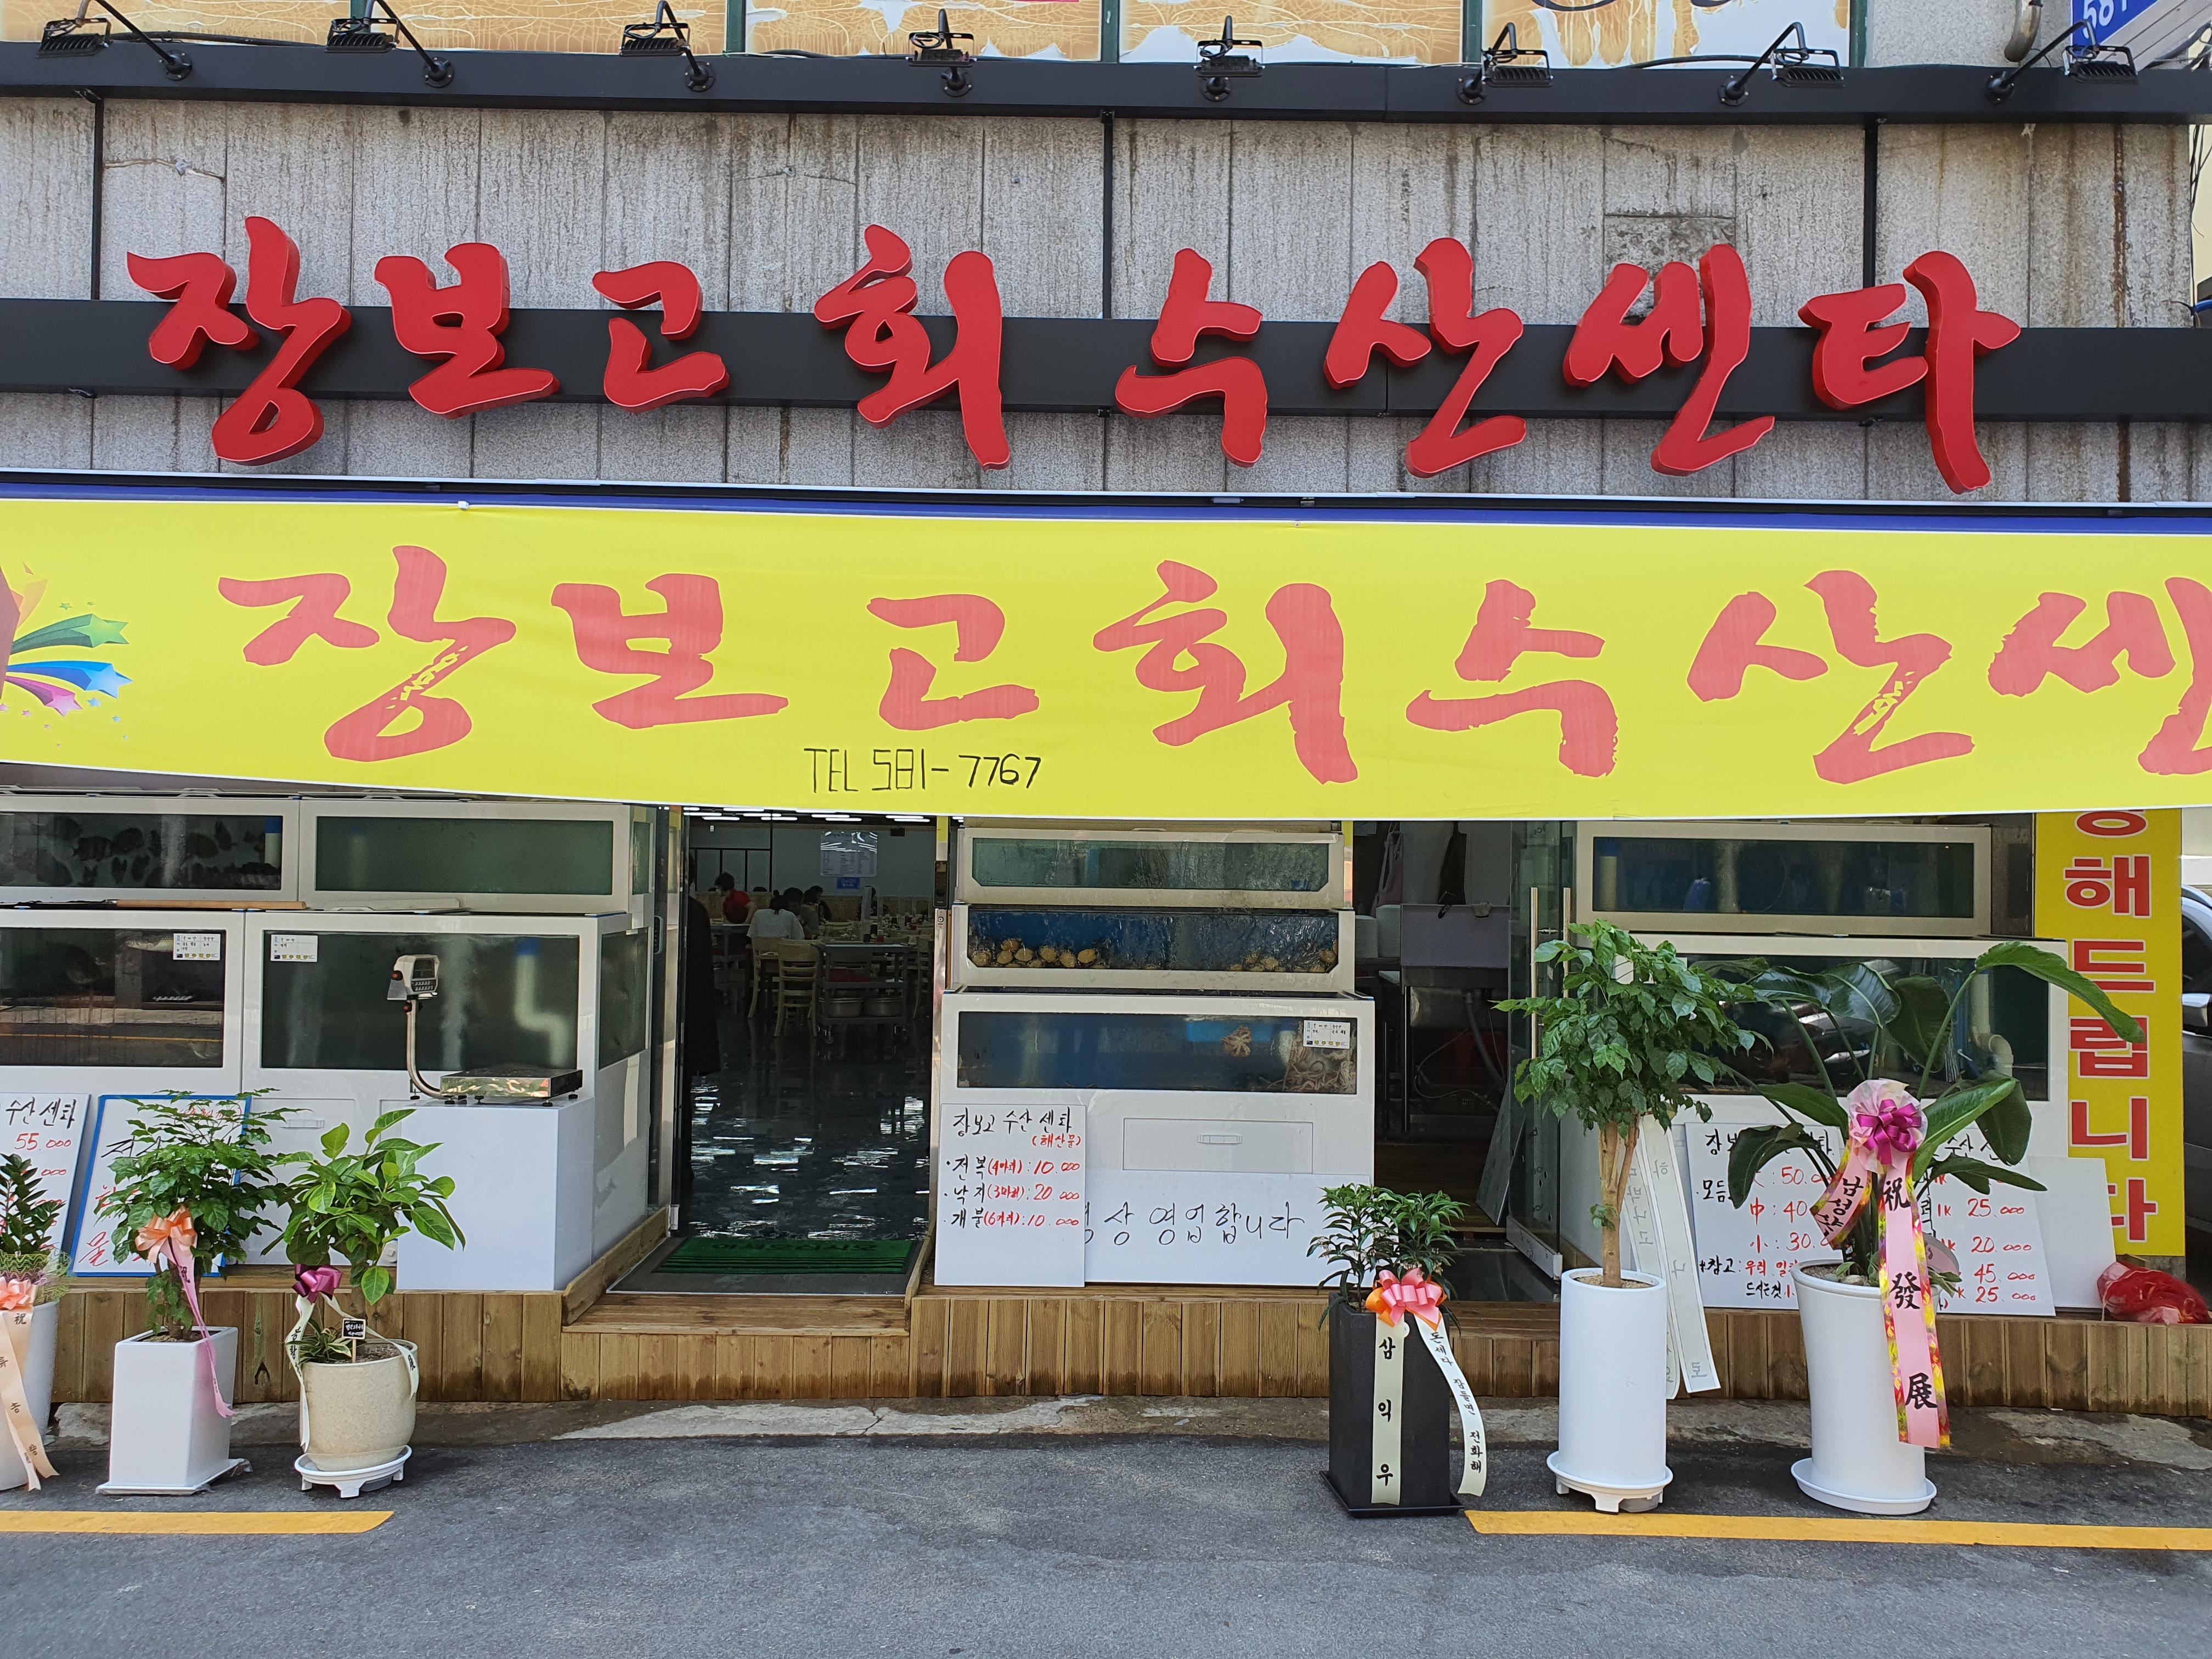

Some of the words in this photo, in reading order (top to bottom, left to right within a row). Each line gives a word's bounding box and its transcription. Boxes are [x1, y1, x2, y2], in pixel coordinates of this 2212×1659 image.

[804, 748, 859, 793] TEL
[872, 748, 1041, 791] 581-7767
[952, 1107, 995, 1137] 장보고
[14, 1132, 72, 1150] 55.000
[1032, 1133, 1081, 1148] (해산물)
[1429, 1331, 1453, 1366] 돈세다
[1469, 1430, 1483, 1474] 전화해
